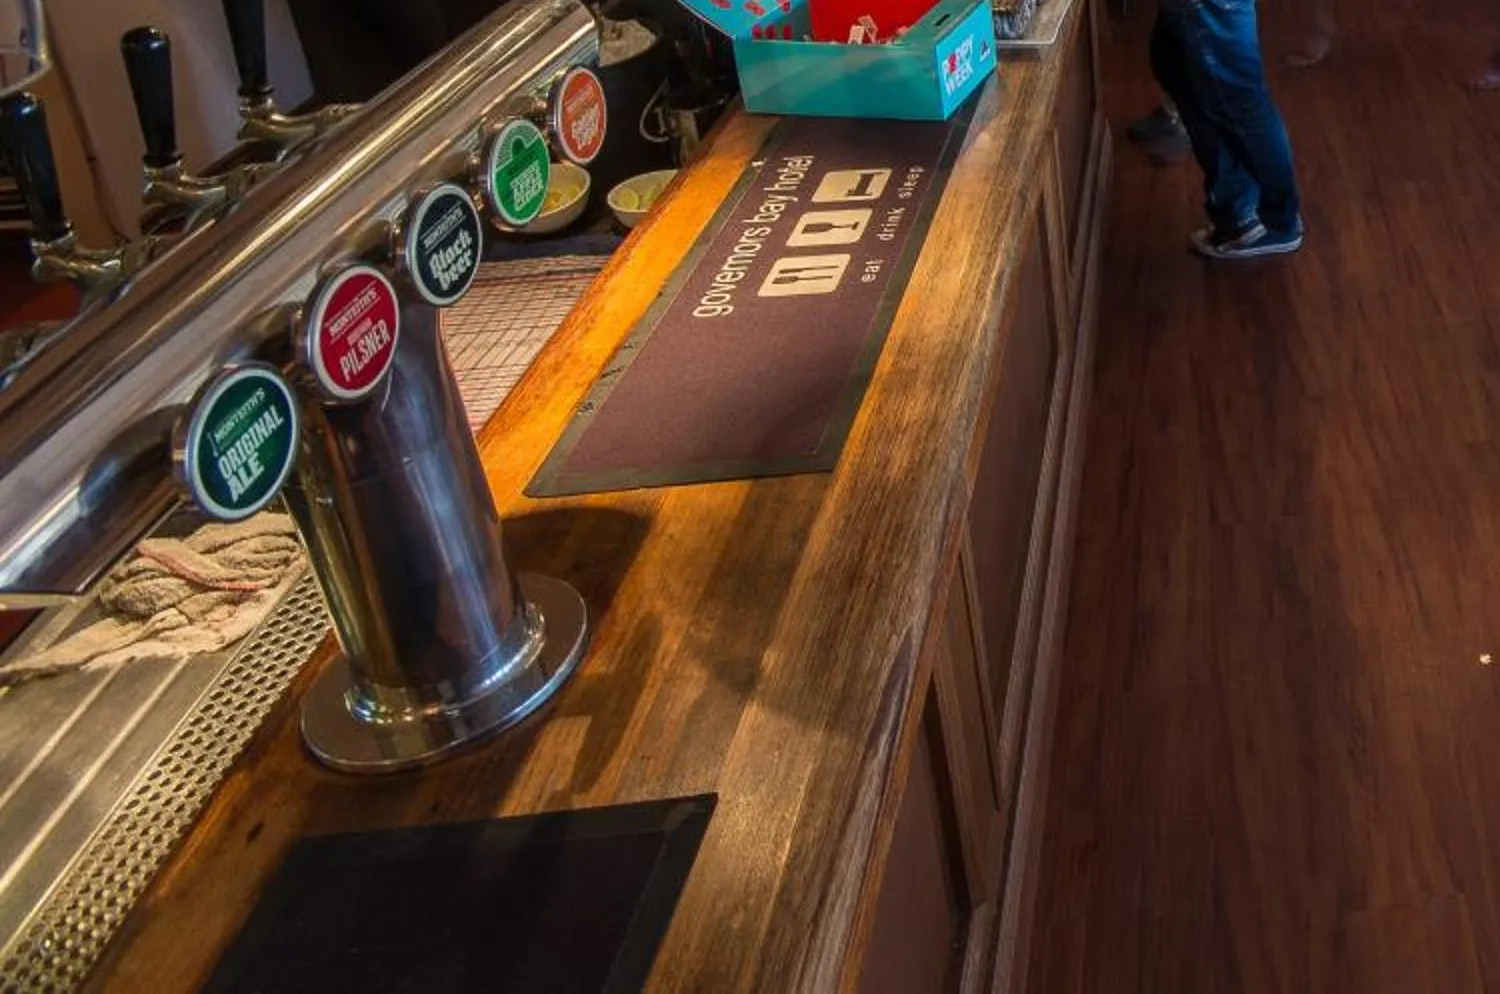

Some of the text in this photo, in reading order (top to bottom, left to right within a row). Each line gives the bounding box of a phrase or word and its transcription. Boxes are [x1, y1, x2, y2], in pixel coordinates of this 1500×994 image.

[692, 155, 815, 318] governors bay hotel
[861, 165, 926, 284] eat drink sleep
[339, 318, 392, 382] PILSNER
[217, 404, 285, 480] ORIGINAL
[227, 451, 265, 503] ALE
